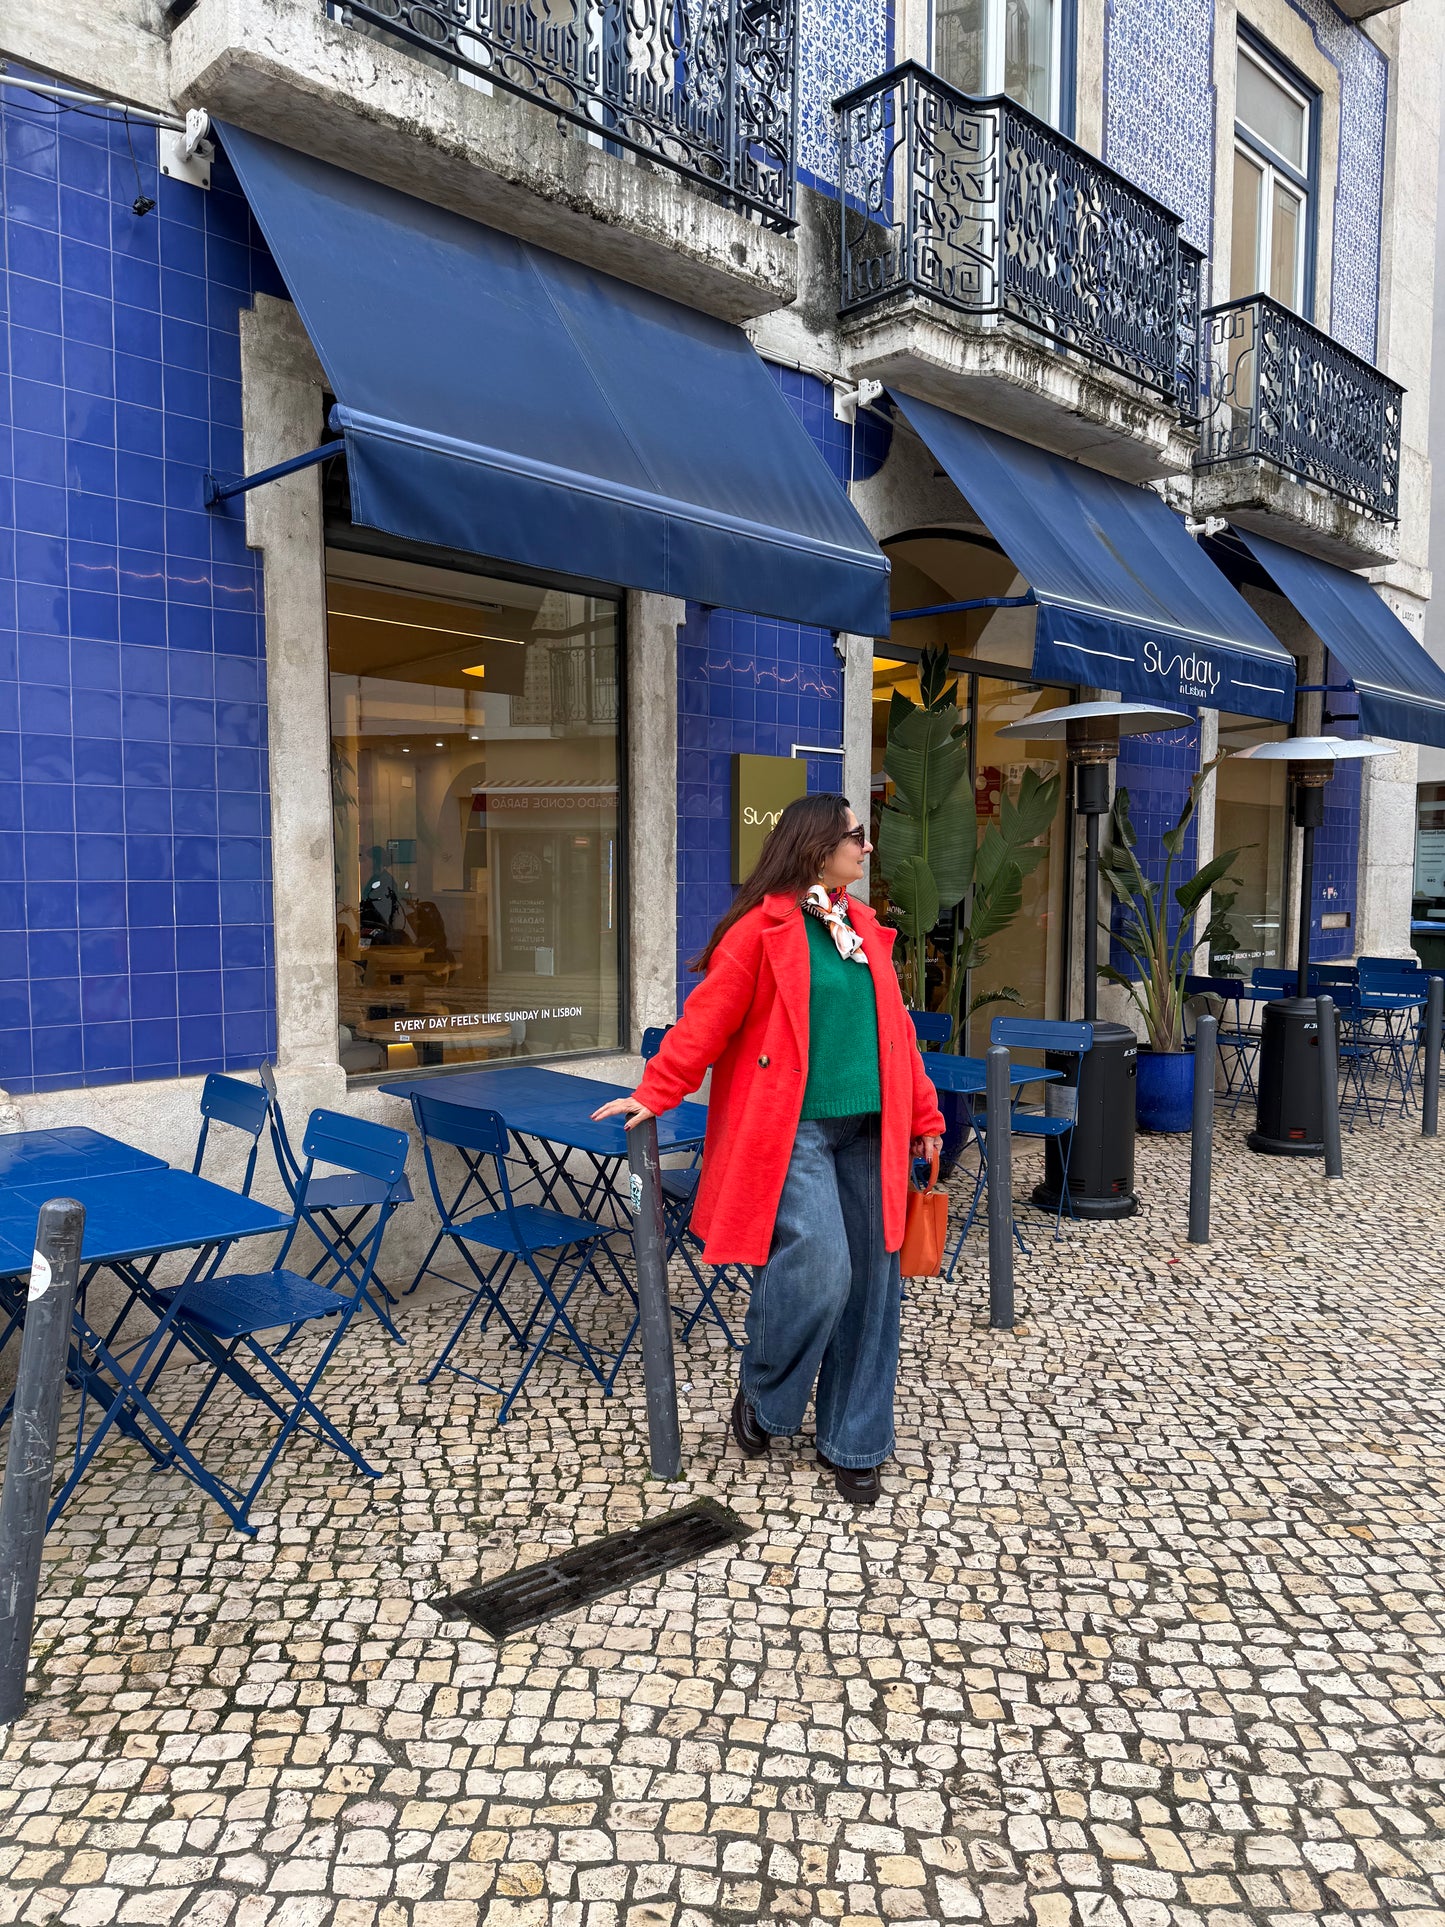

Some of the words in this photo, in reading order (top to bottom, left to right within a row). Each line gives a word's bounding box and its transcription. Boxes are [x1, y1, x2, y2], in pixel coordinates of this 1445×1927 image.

[1144, 641, 1220, 694] Sunday
[1180, 681, 1185, 694] in
[1185, 683, 1207, 698] Lisbon
[394, 1019, 425, 1032] EVERY
[429, 1017, 448, 1029] DAY
[451, 1014, 479, 1027] FEELS
[482, 1012, 502, 1024] LIKE
[504, 1009, 539, 1022] SUNDAY
[541, 1008, 550, 1019] IN
[552, 1006, 582, 1018] LISBON
